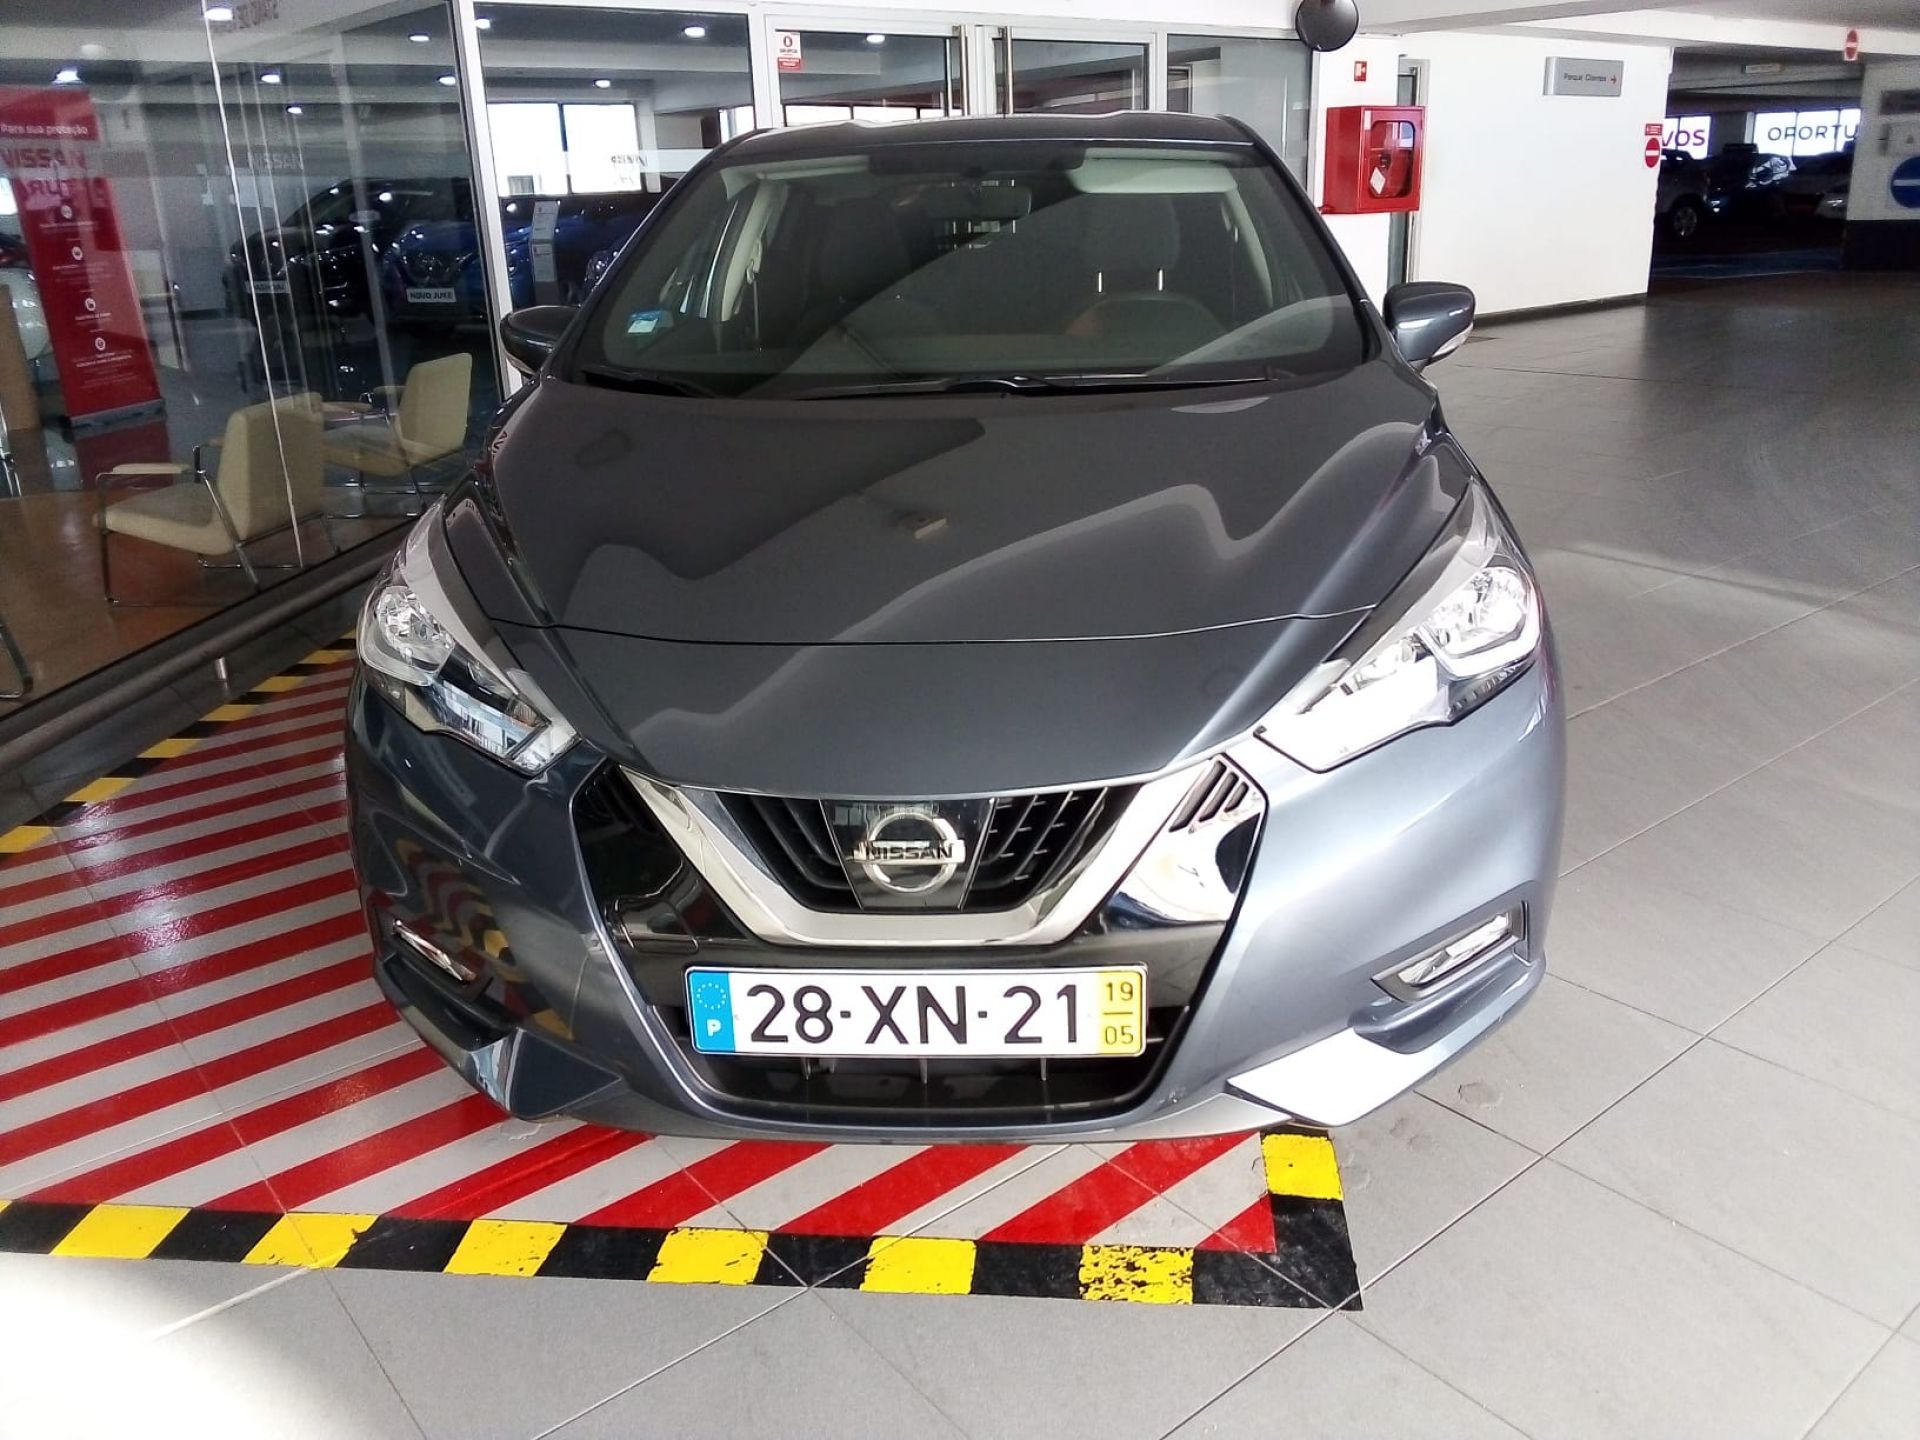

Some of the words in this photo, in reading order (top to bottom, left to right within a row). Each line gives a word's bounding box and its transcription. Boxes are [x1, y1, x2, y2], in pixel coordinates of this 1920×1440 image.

[872, 845, 953, 860] NISSAN
[1105, 981, 1135, 1002] 19
[706, 1018, 721, 1038] P
[1104, 1024, 1135, 1045] 05
